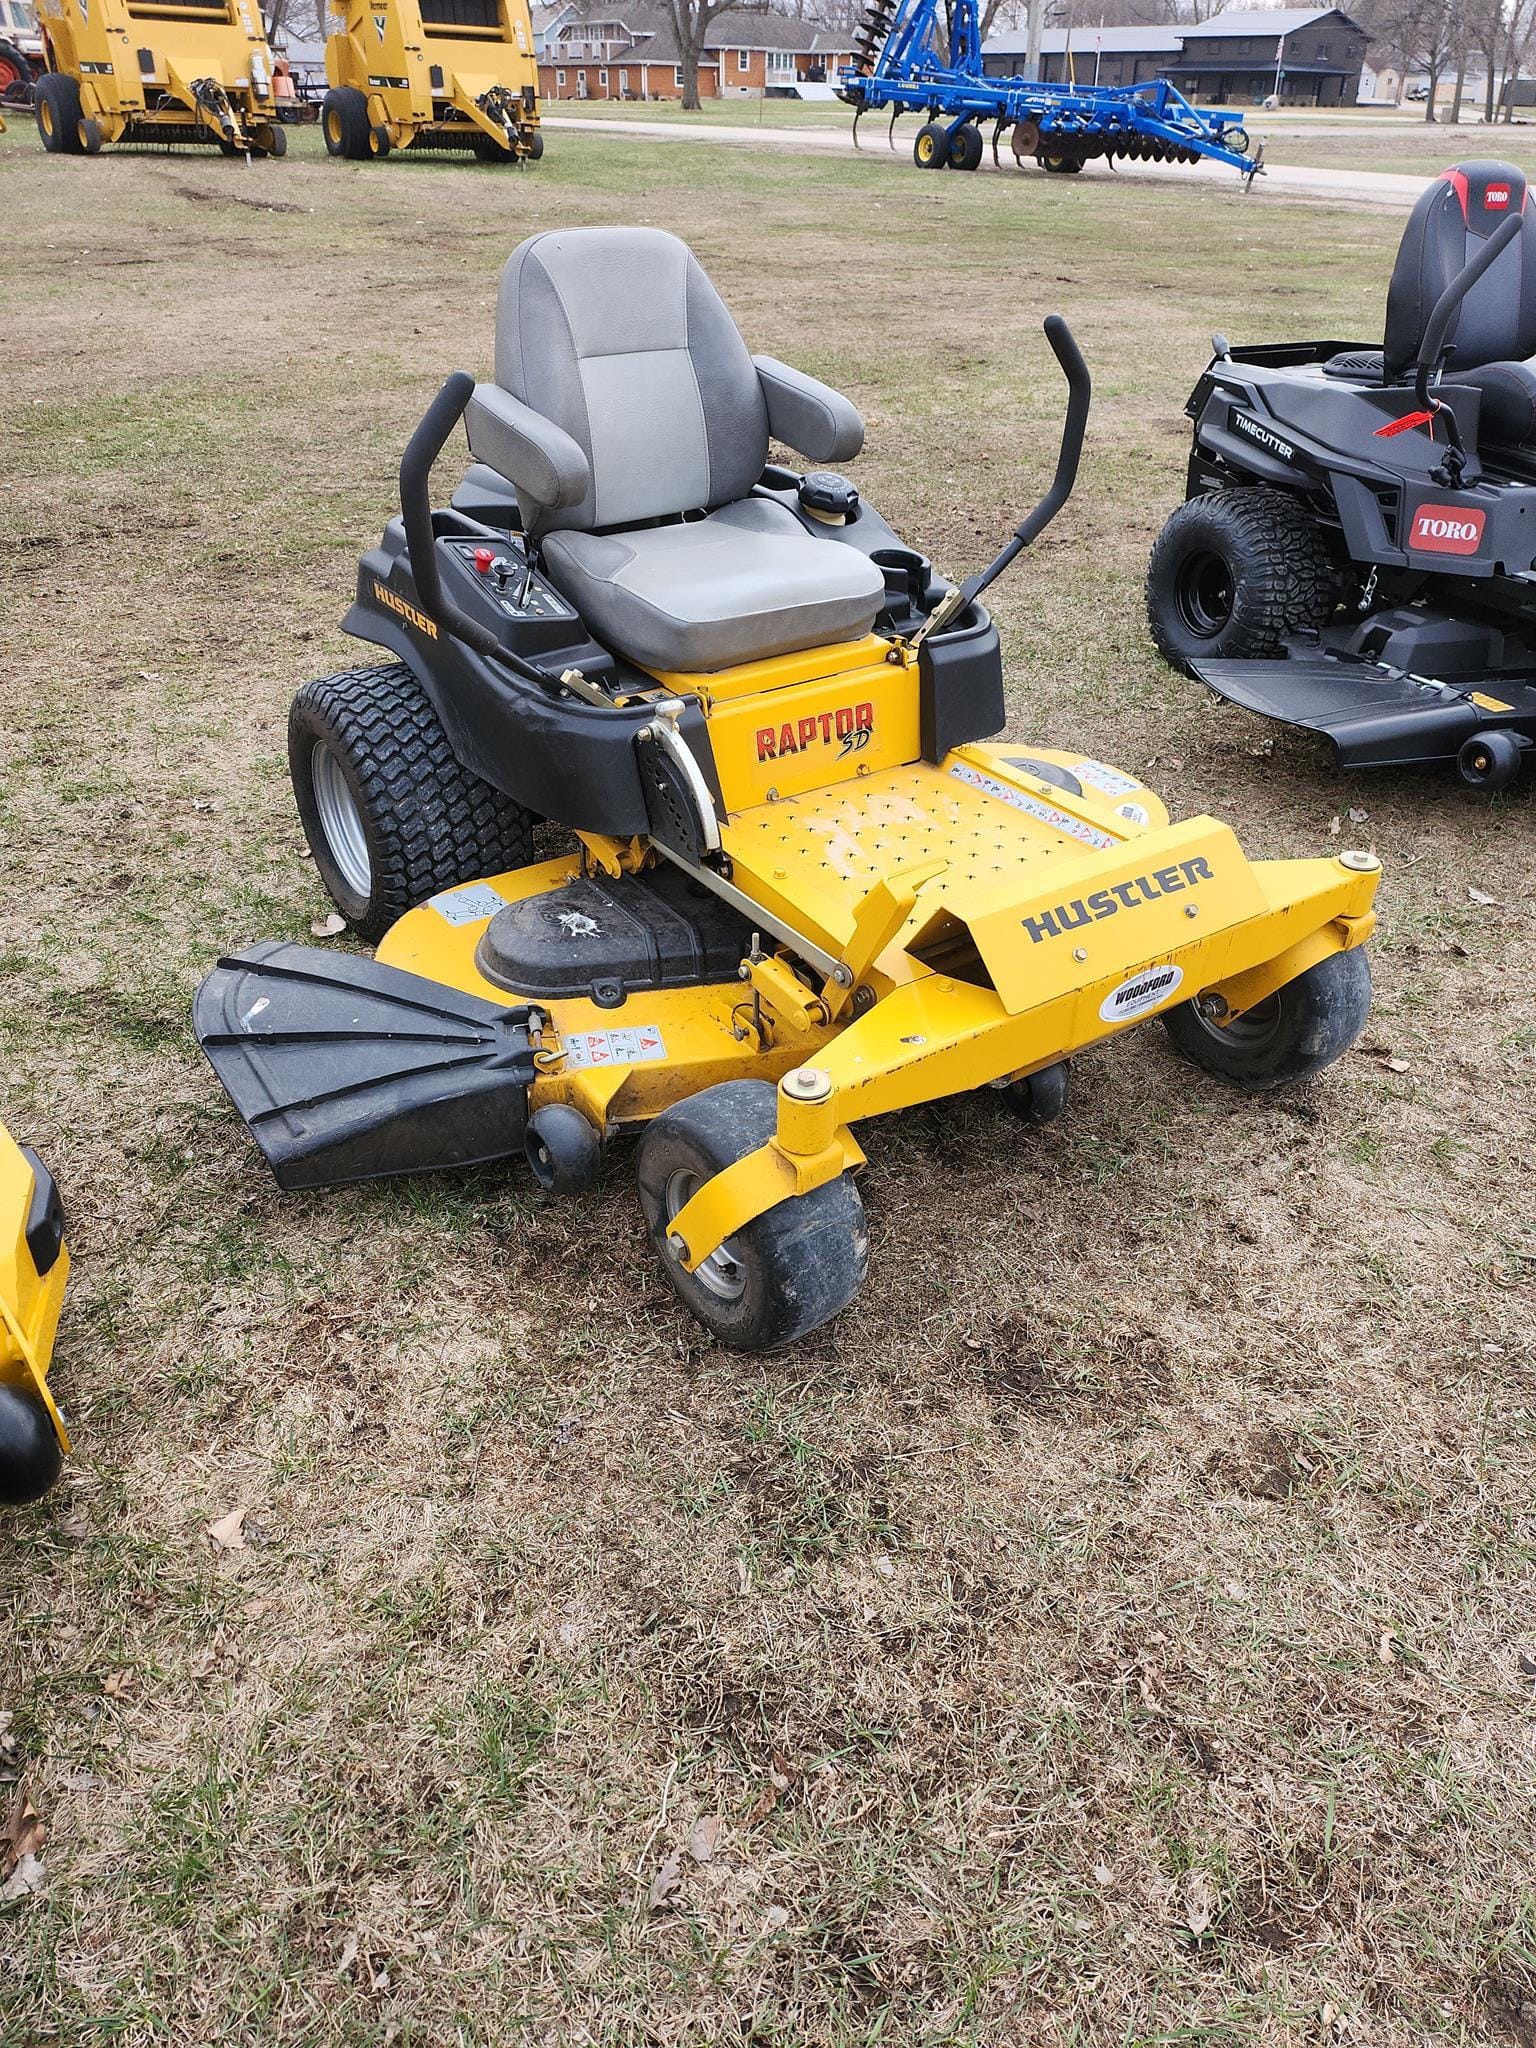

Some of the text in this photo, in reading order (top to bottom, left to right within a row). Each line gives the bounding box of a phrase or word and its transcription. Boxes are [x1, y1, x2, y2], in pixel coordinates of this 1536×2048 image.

[1486, 191, 1508, 202] TORO
[1235, 413, 1293, 459] TIMECUTTER
[1418, 518, 1477, 540] TORO
[373, 581, 438, 641] HUSTLER
[756, 702, 874, 763] RAPTOR
[836, 729, 870, 761] SD
[1021, 856, 1214, 944] HUSTLER
[1115, 971, 1175, 1006] WOODFORD
